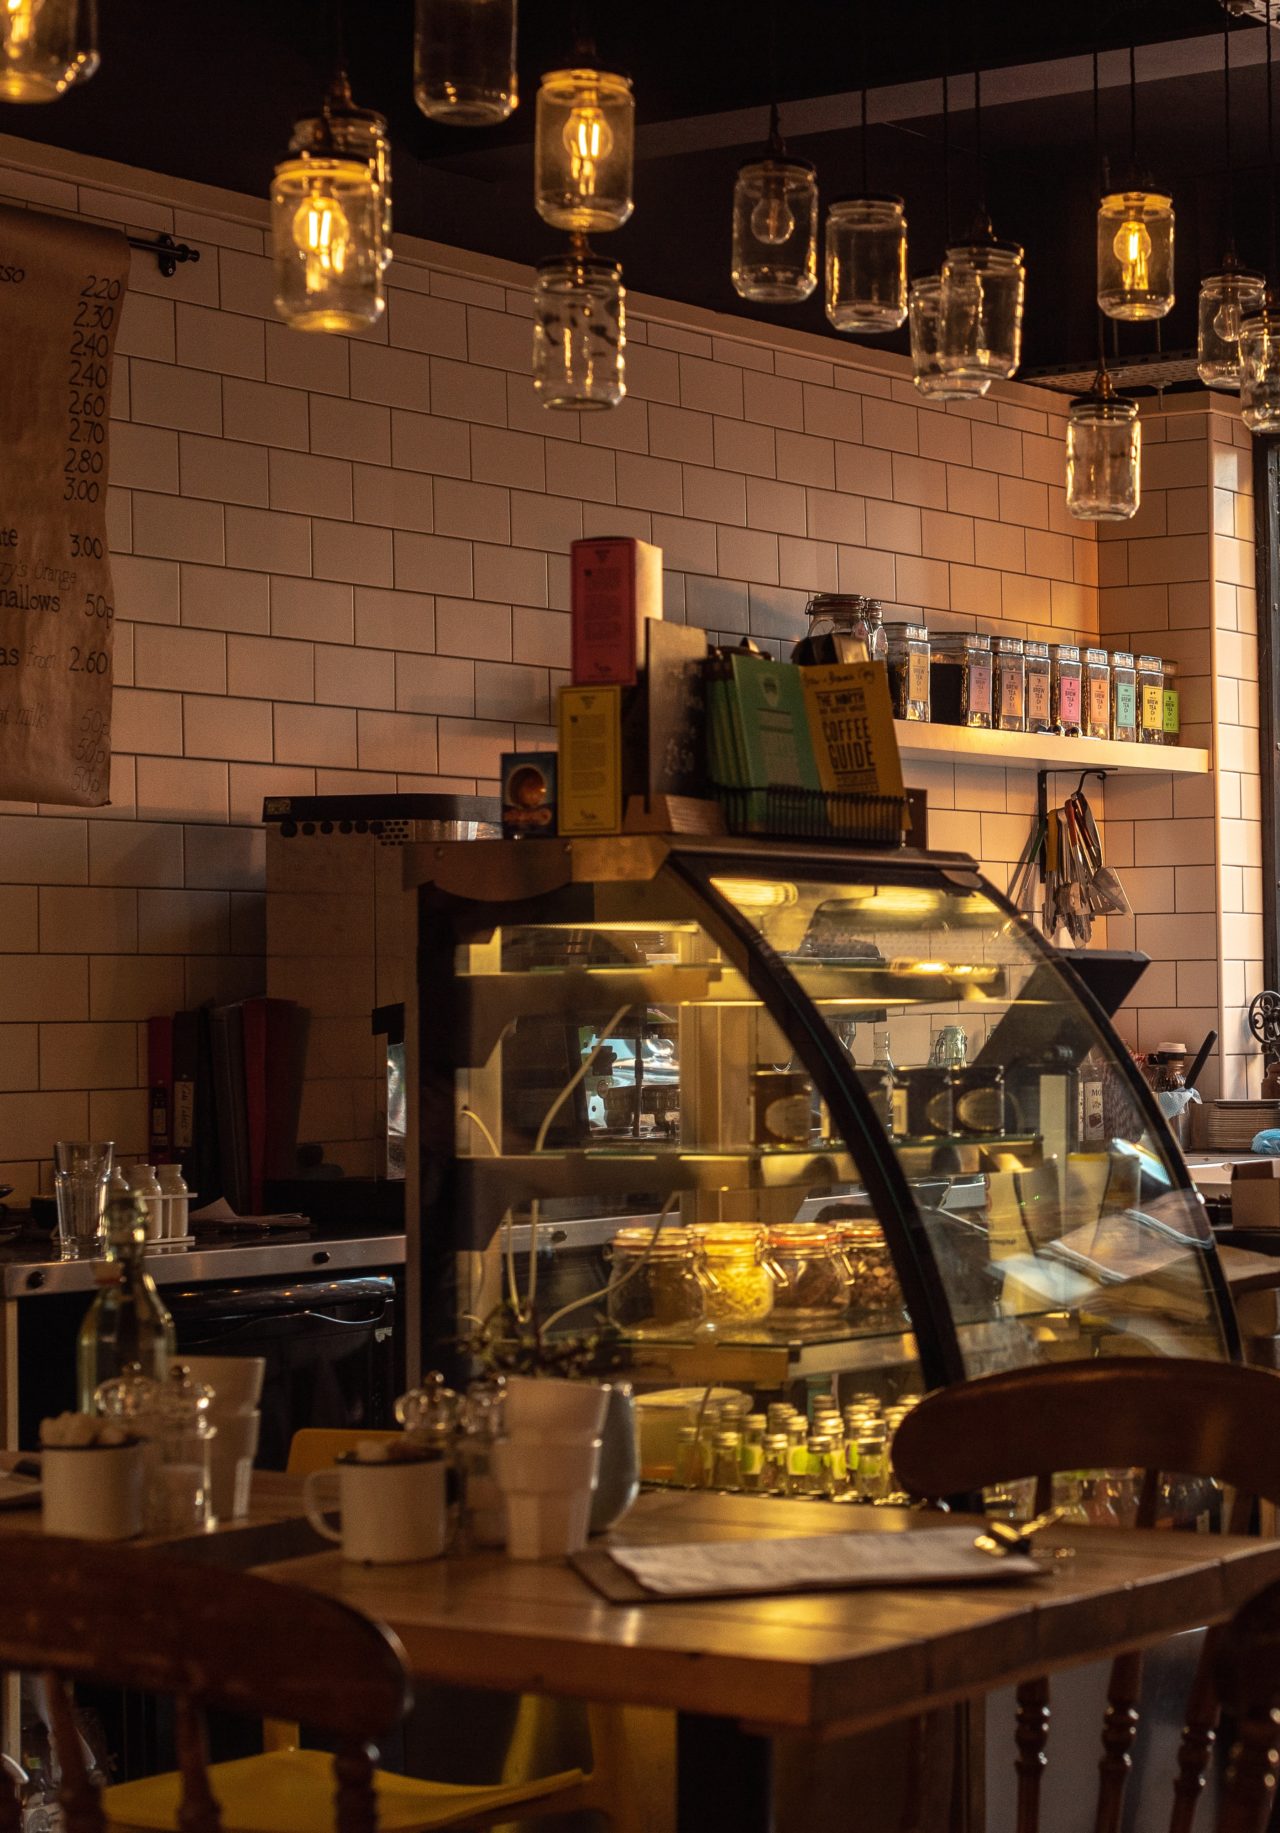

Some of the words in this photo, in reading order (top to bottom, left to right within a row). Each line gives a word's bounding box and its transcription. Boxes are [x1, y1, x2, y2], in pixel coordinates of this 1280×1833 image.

[81, 275, 121, 301] 2.20
[74, 301, 114, 330] 2.30
[70, 331, 109, 358] 2.40
[69, 360, 107, 389] 2.40
[69, 390, 105, 417] 2.60
[69, 418, 104, 443] 2.70
[64, 448, 103, 474] 2.80
[63, 477, 99, 503] 3.00
[70, 533, 103, 560] 3.00
[85, 594, 115, 630] 50p
[69, 646, 108, 675] 2.60
[822, 717, 871, 743] COFFEE
[827, 740, 877, 770] GUIDE
